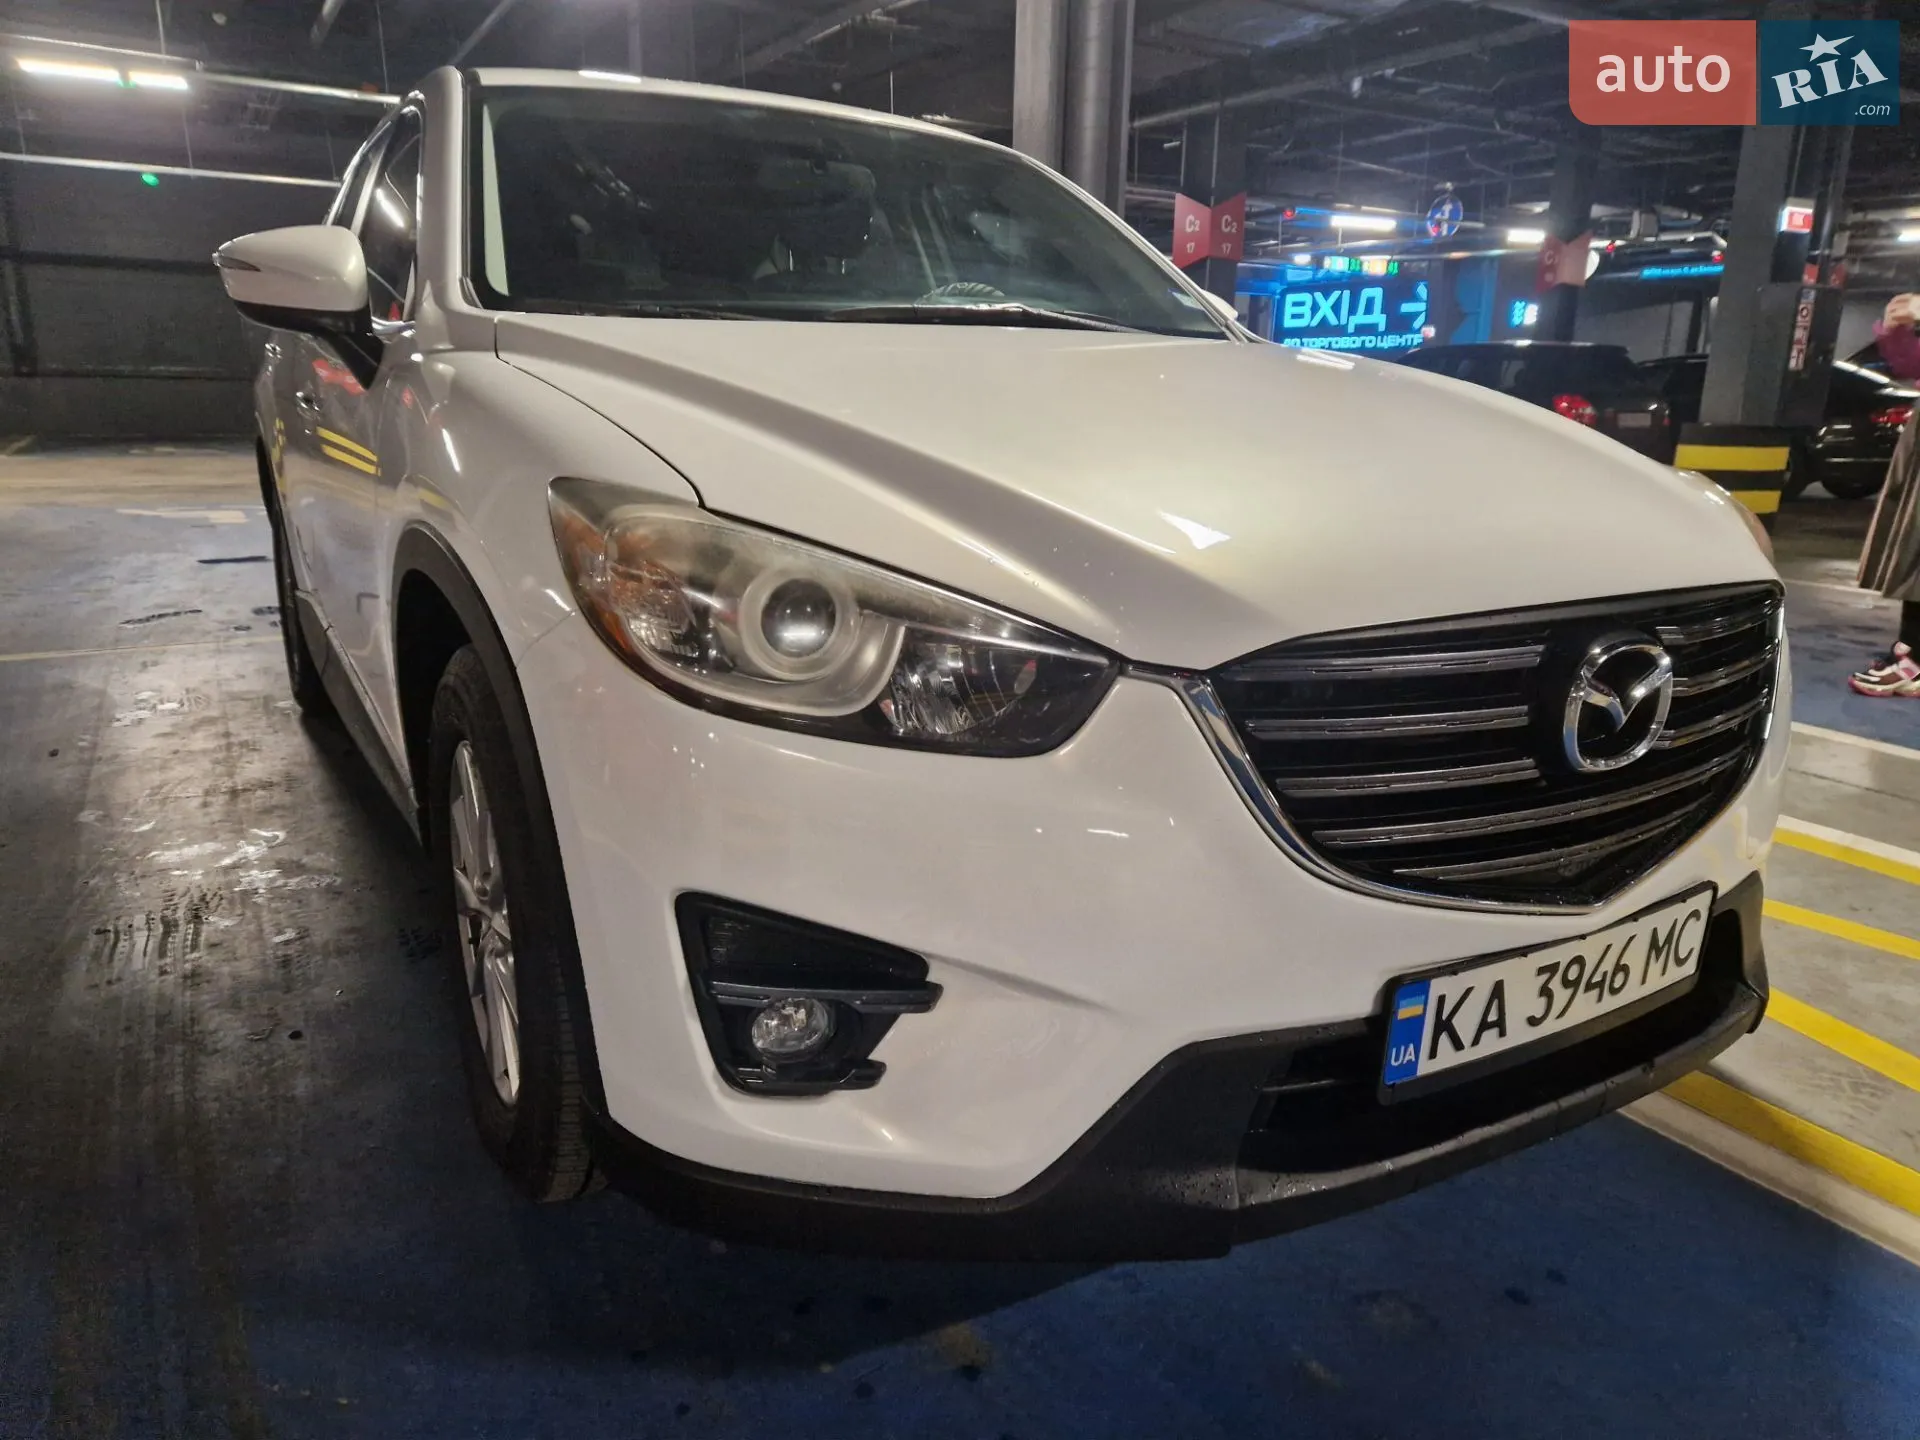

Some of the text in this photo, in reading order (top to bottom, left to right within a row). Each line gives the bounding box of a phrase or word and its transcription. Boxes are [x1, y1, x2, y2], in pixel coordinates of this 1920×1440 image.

[1284, 287, 1387, 334] ВХІД
[1302, 335, 1376, 349] ТОРГОВОГО
[1376, 333, 1424, 349] ЦЕНТР
[1428, 909, 1701, 1060] KA 3946 MC
[1390, 1043, 1416, 1067] UA
